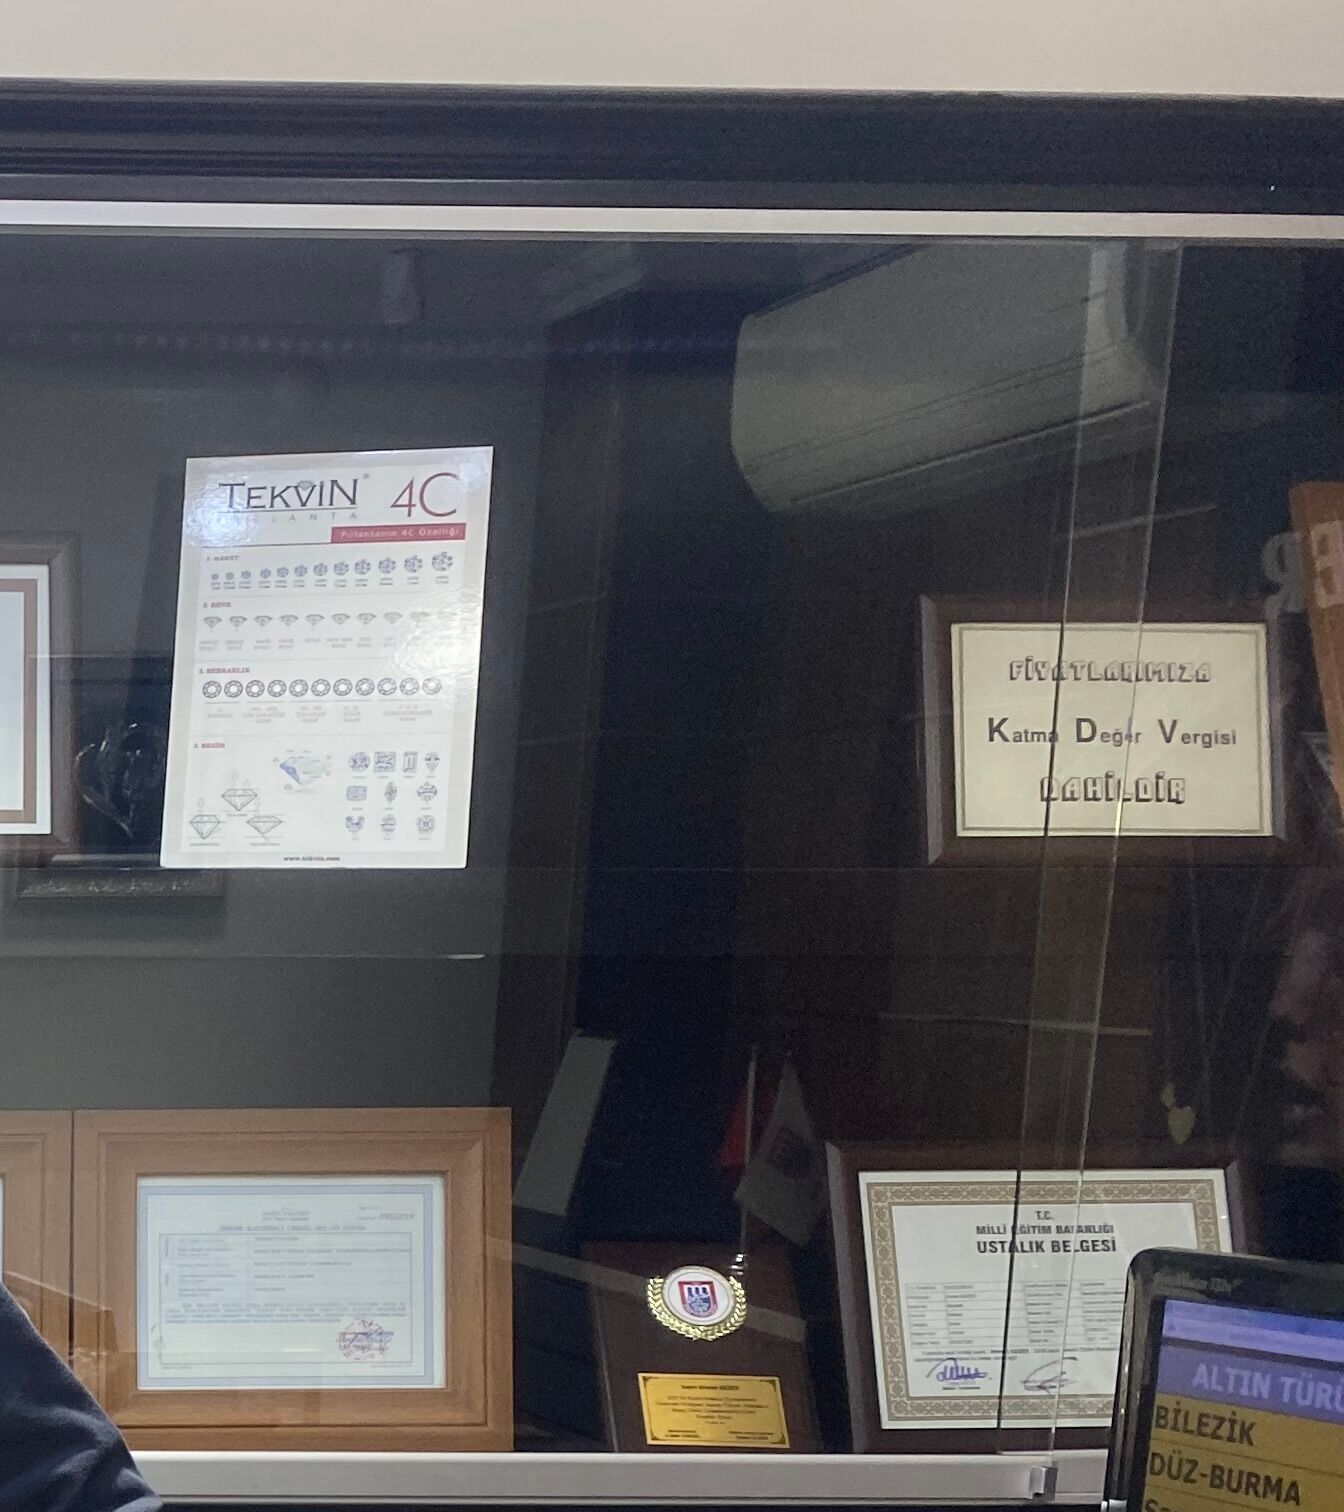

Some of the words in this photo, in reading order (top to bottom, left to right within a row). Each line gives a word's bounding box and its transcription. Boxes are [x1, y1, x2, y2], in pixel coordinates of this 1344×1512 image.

[390, 472, 460, 517] 4C
[1009, 656, 1211, 684] FİYATLARIMIZA
[988, 716, 1058, 743] Katma
[1076, 717, 1141, 748] Değer
[1158, 718, 1237, 749] Vergisi
[1040, 771, 1186, 804] DAHİLDİR
[977, 1240, 1045, 1254] USTALIK
[1192, 1363, 1271, 1399] ALTIN
[1155, 1401, 1256, 1446] BİLEZİK
[1149, 1450, 1301, 1505] DÜZ-BURMA
